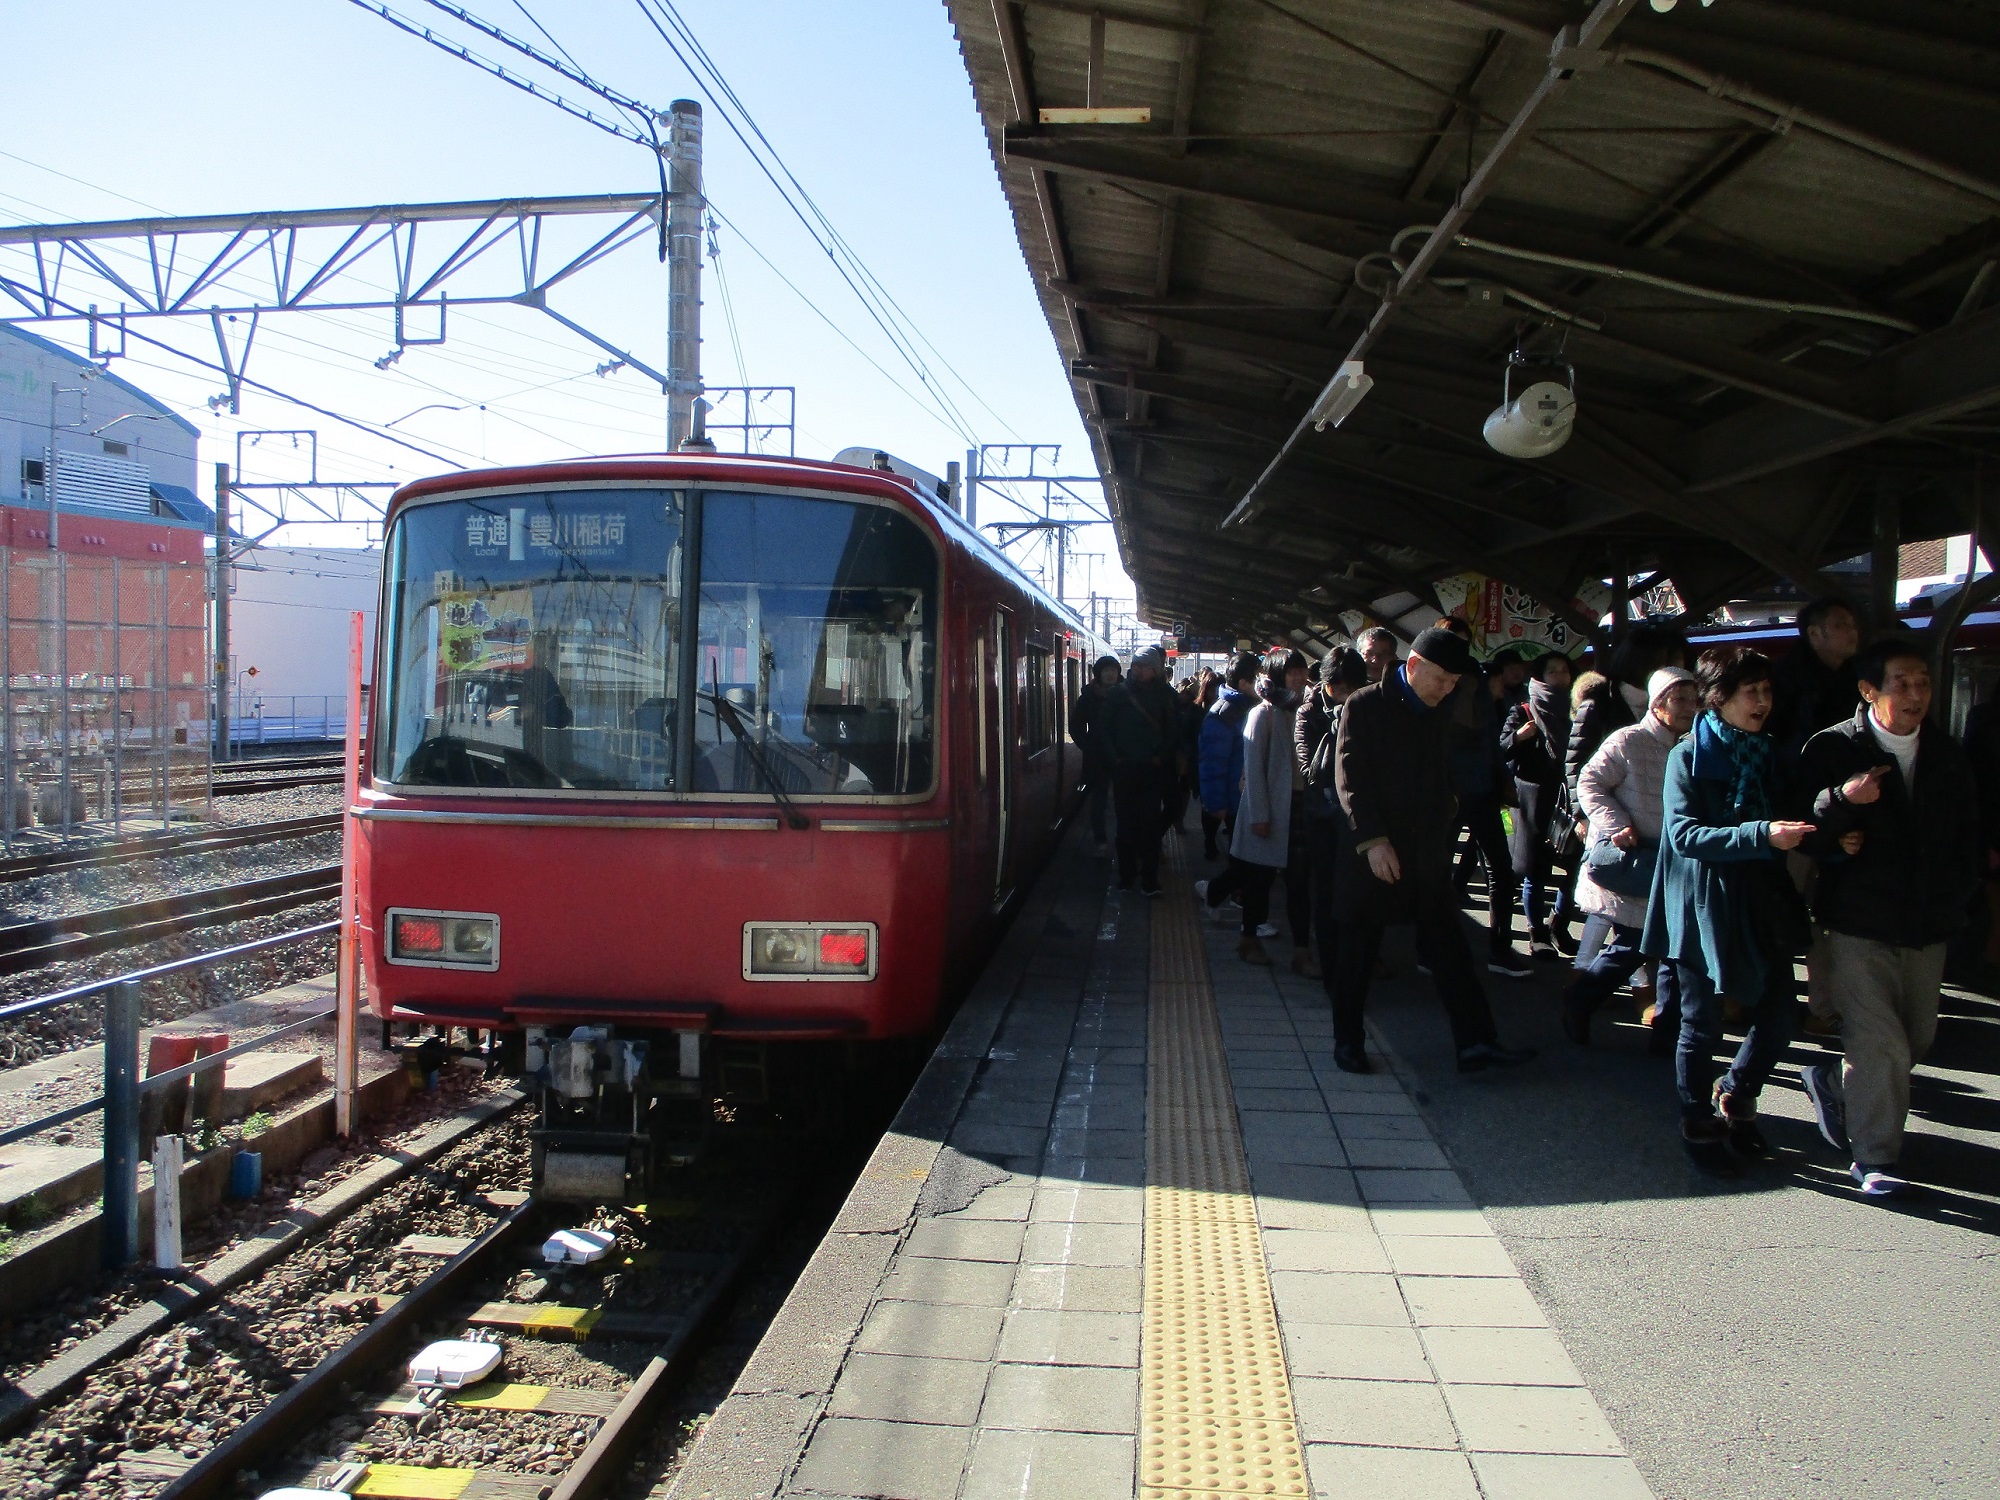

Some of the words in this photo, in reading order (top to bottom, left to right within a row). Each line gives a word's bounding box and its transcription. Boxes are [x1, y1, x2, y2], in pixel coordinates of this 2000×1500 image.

[466, 514, 508, 547] 普通
[530, 513, 626, 547] 豊川稲荷
[475, 547, 499, 556] Local
[1175, 624, 1184, 635] 2
